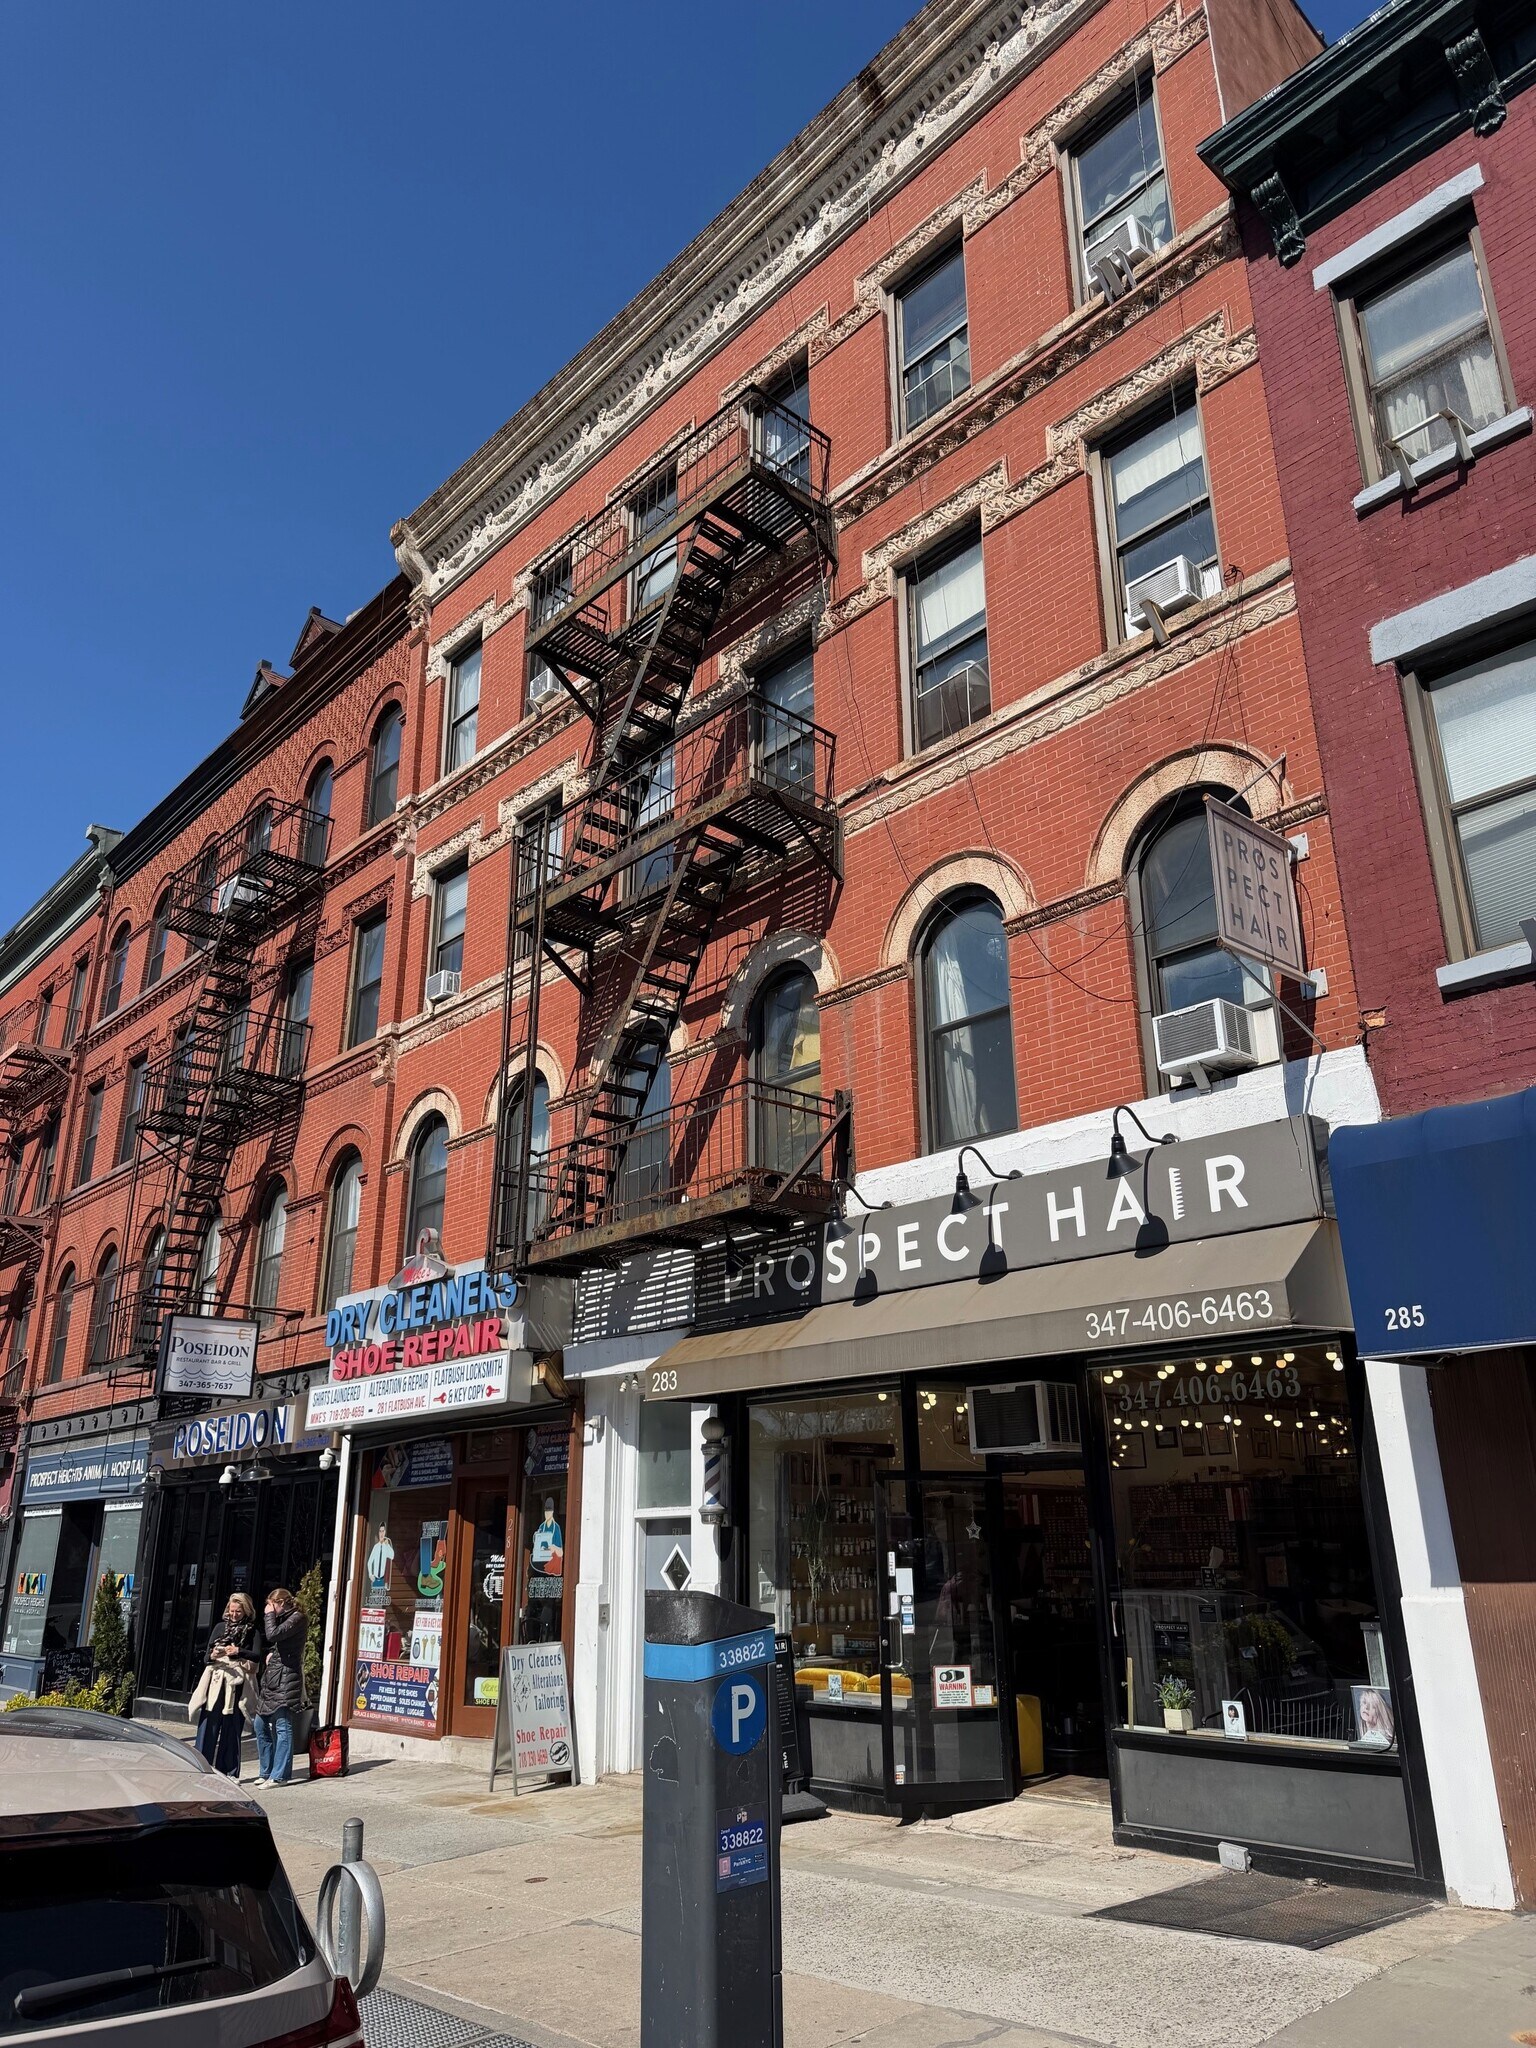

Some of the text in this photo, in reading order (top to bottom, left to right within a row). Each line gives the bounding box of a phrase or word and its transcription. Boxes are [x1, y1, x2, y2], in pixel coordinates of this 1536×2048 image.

[1223, 829, 1279, 880] PROS
[1226, 867, 1282, 915] PECT
[723, 1154, 1249, 1303] PROSPECT HAIR
[325, 1271, 519, 1347] DRY CLEANERS
[1085, 1289, 1273, 1339] 347-406-6463
[1385, 1304, 1425, 1331] 285
[171, 1336, 250, 1358] POSEIDON
[332, 1318, 503, 1381] SHOE REPAIR
[176, 1357, 210, 1366] RESTAURANT
[178, 1381, 234, 1391] 347-365-7637
[312, 1359, 503, 1407] SHIRTS LAUNDERED ALTERATION & REPAIR FLATBUSH LOCKSMITH
[448, 1383, 486, 1403] & KEY COPY
[651, 1370, 678, 1393] 283
[1118, 1367, 1301, 1412] 347.406.6463
[310, 1409, 327, 1424] MIKE'S
[377, 1402, 388, 1415] 281
[388, 1397, 414, 1413] FLATBUSH
[413, 1394, 427, 1409] AVE.
[173, 1406, 291, 1459] POSEIDON
[30, 1459, 145, 1487] PROSPECT HEIGHTS ANIMAL HOSPITAL
[511, 1653, 562, 1674] Dry Cleaners
[719, 1641, 766, 1668] 338822
[370, 1662, 430, 1684] SHOE REPAIR
[532, 1671, 563, 1690] Alterations
[939, 1683, 967, 1691] WARNING
[534, 1692, 565, 1712] Tailoring
[731, 1684, 756, 1744] P
[516, 1723, 567, 1744] Shoe Repair
[721, 1827, 763, 1852] 338822
